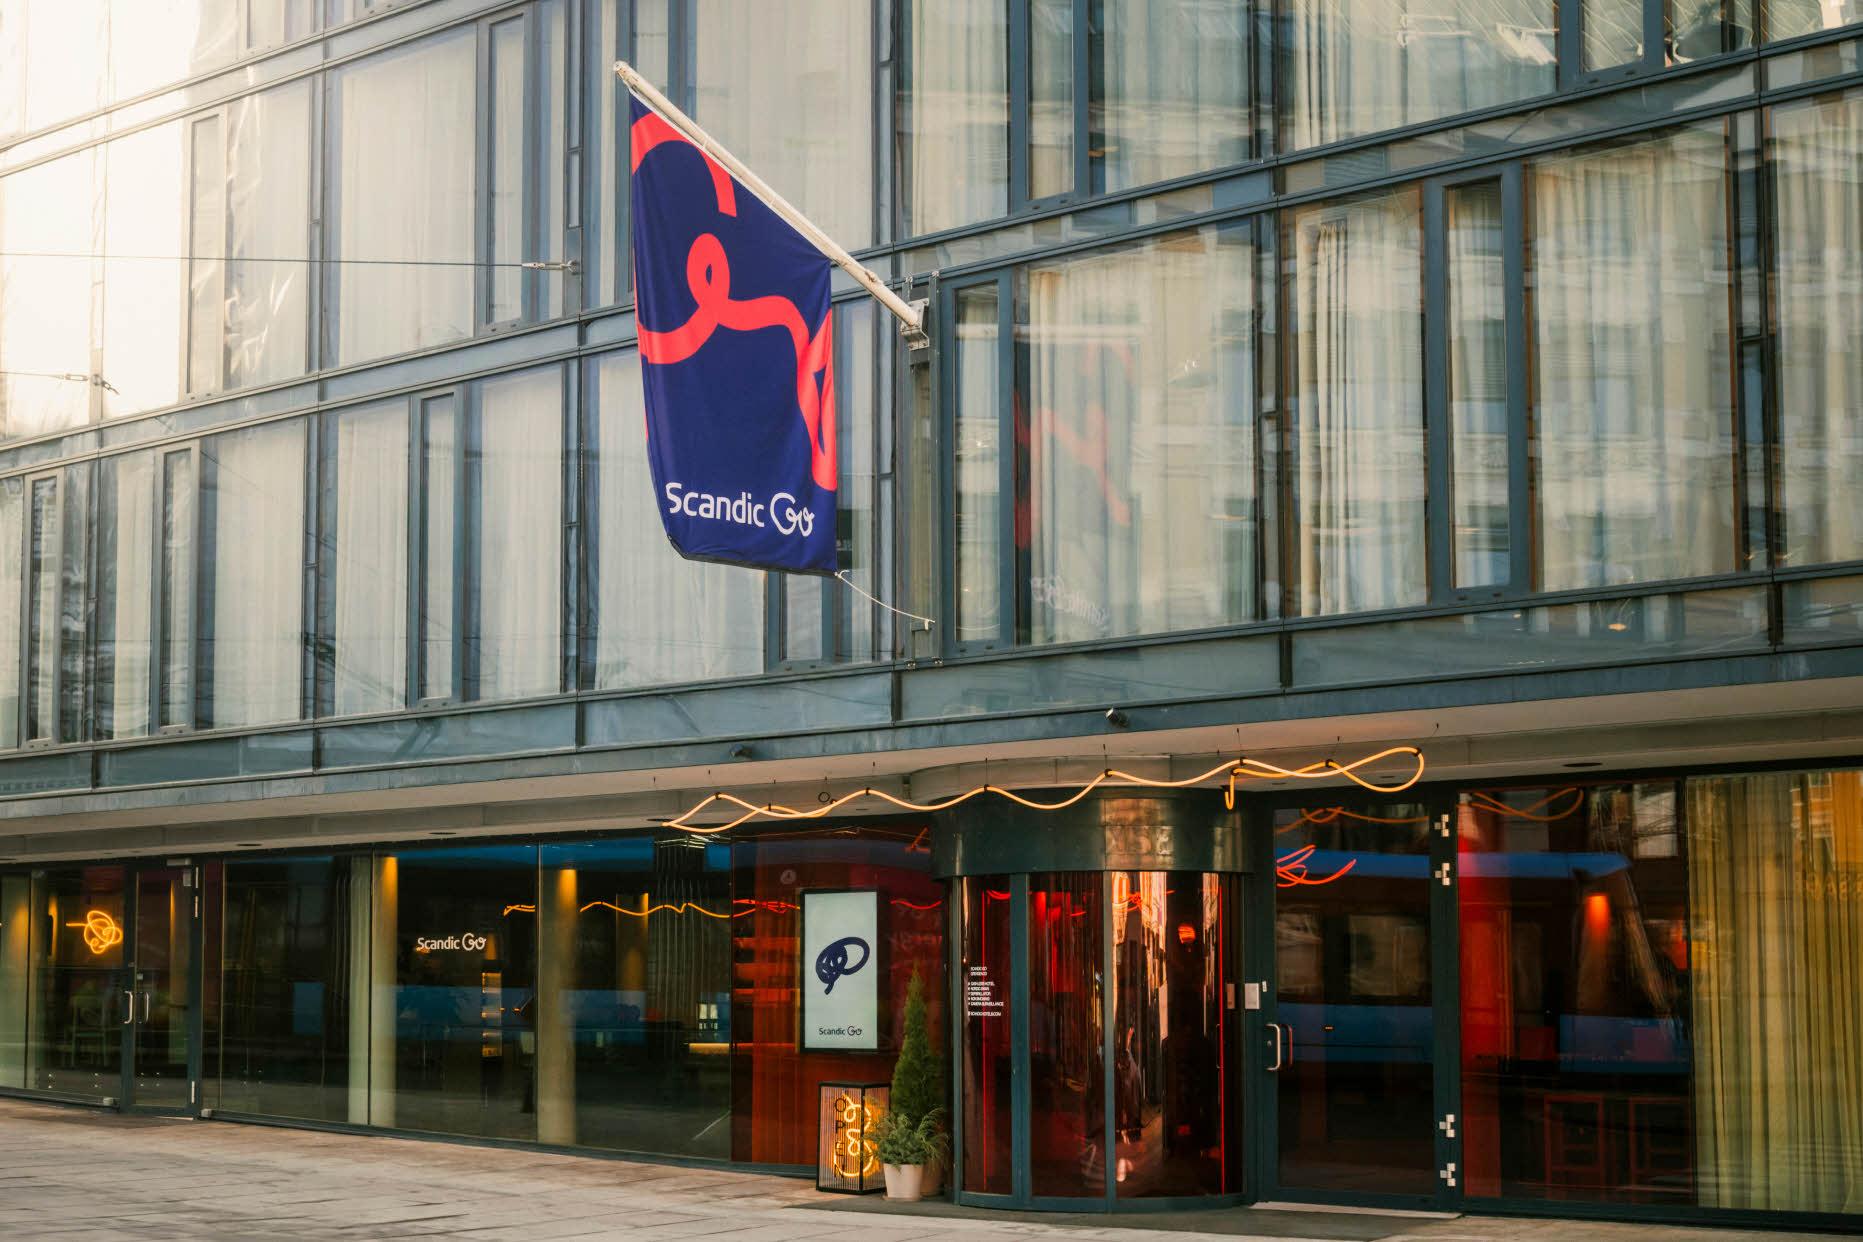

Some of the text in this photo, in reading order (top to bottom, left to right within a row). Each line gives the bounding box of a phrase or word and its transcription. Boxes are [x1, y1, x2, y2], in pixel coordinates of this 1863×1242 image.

[665, 482, 815, 537] Scandic Go
[417, 932, 487, 951] Scandic Go
[818, 1025, 863, 1036] Scandic Go
[835, 1098, 847, 1179] OPEN
